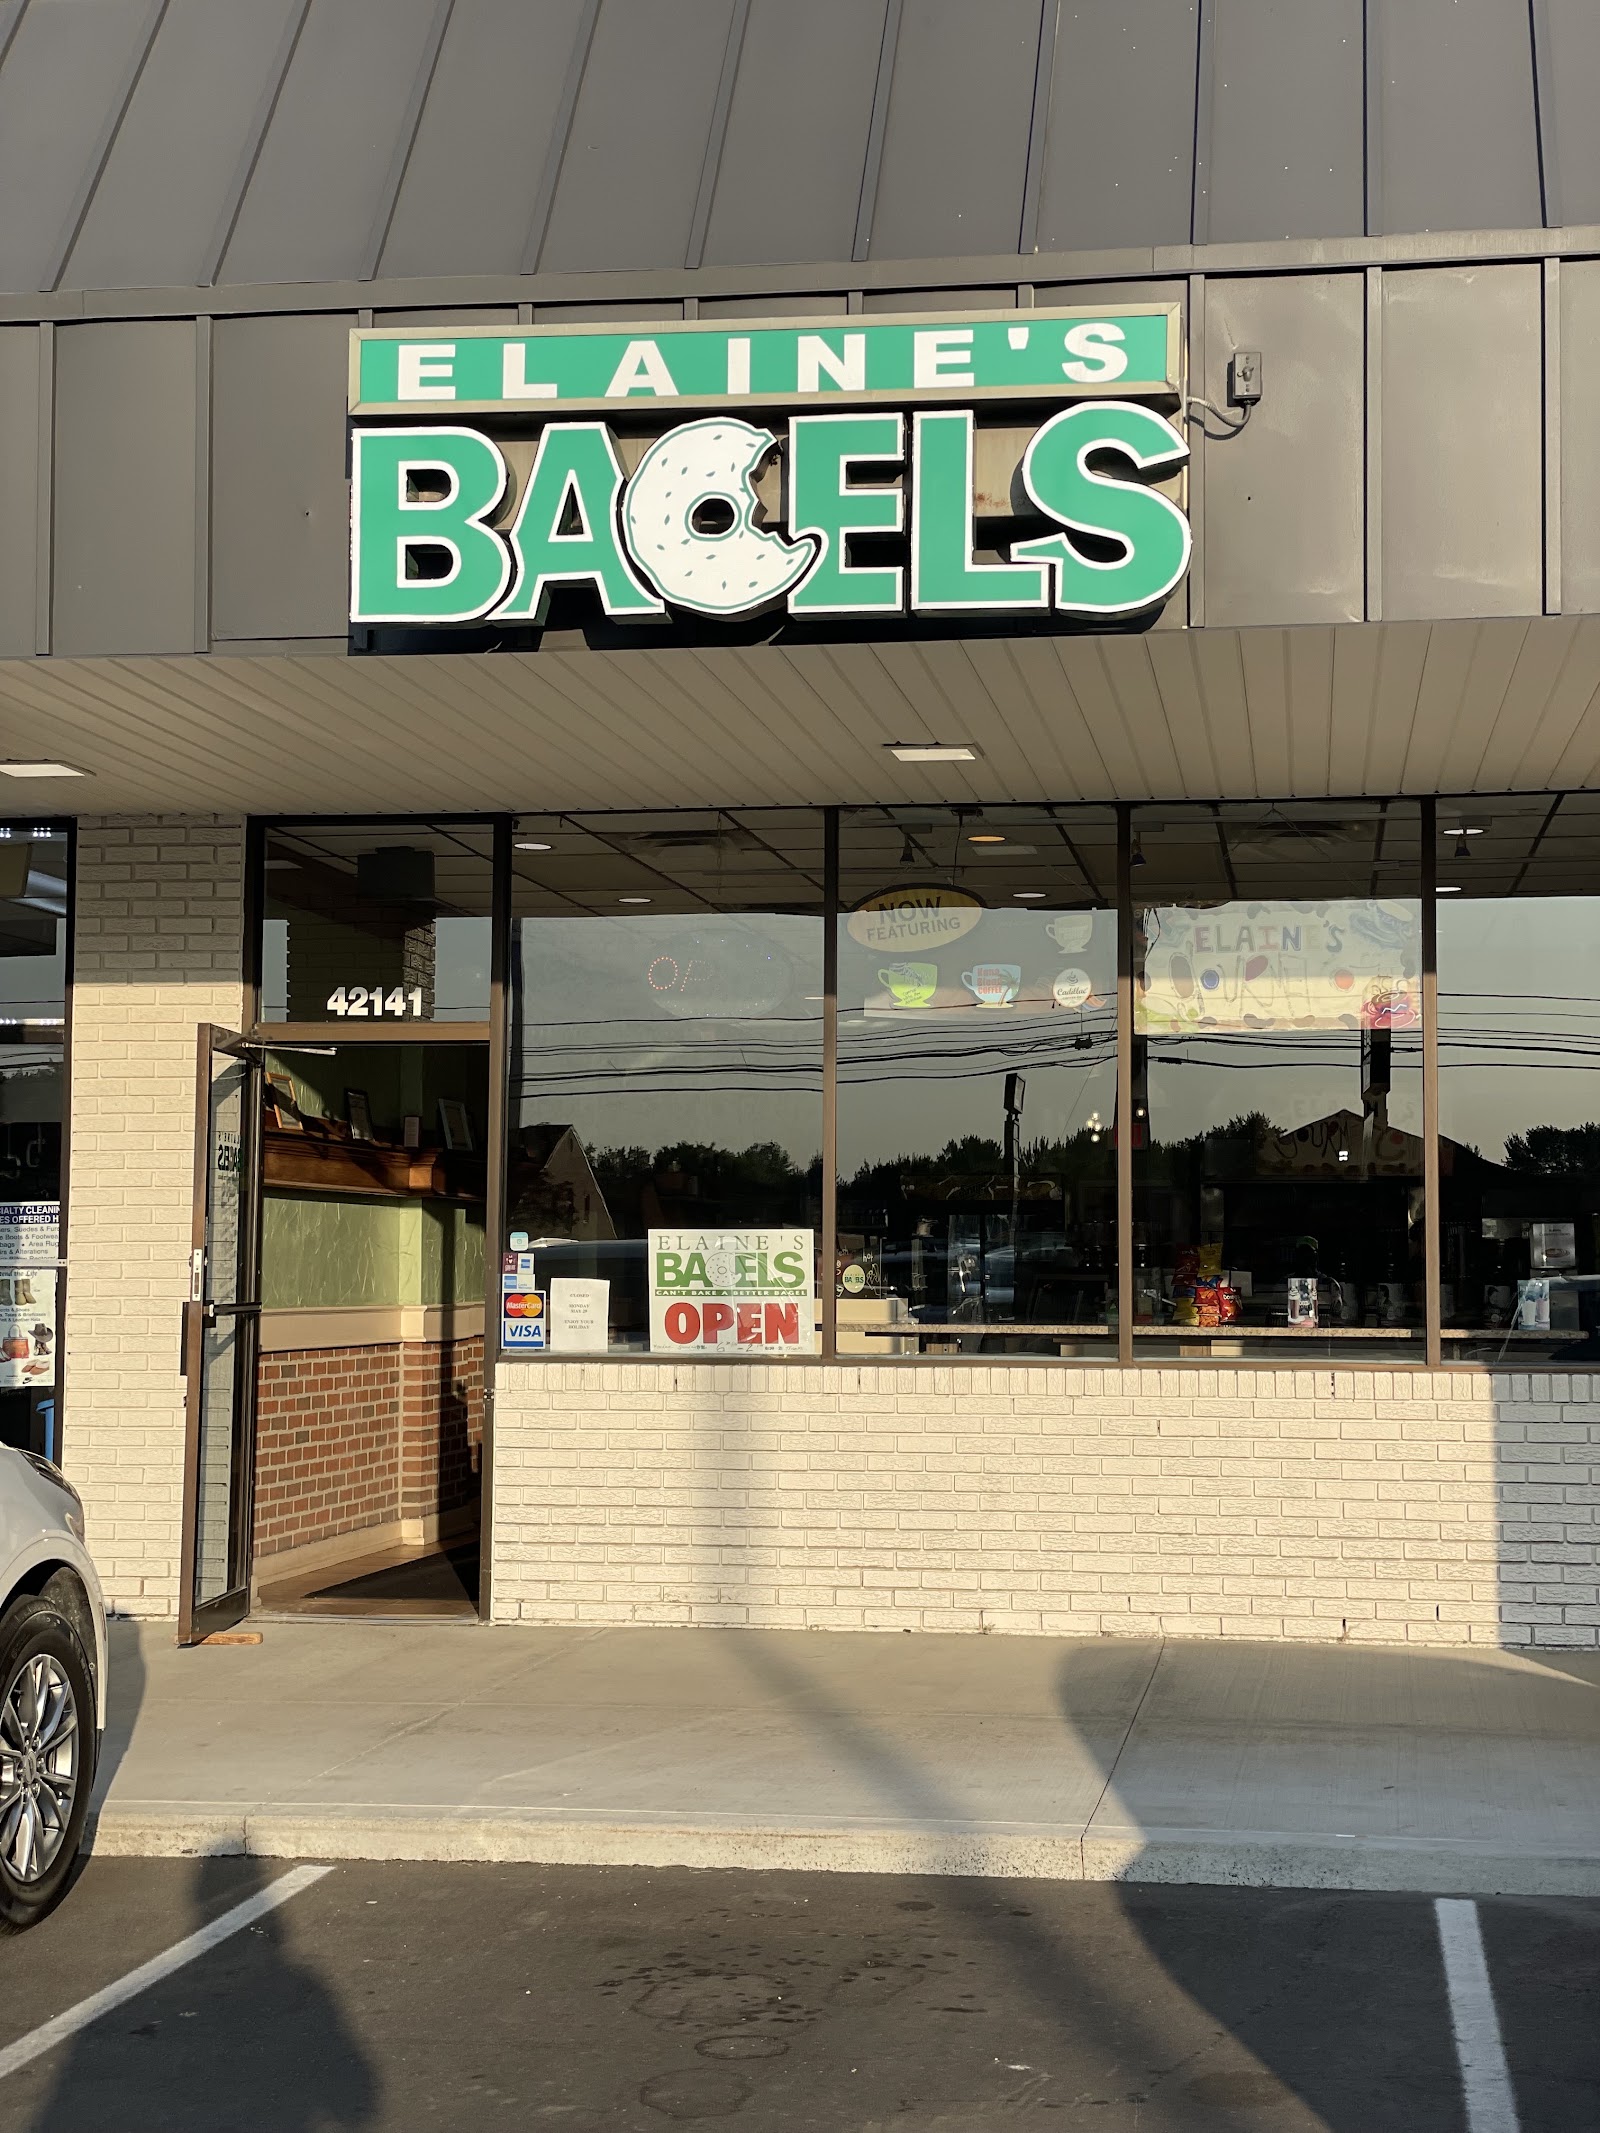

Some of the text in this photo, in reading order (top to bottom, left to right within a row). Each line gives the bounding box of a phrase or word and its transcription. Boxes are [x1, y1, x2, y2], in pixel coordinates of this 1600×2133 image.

[396, 320, 1130, 401] ELAINE'S
[350, 400, 1192, 625] BAGELS
[878, 896, 942, 925] NOW
[866, 916, 961, 942] FEATURING
[326, 986, 422, 1017] 42141
[1057, 986, 1088, 997] Cadillac
[12, 1214, 51, 1224] OFFERED
[657, 1235, 805, 1251] ELAINE'S
[506, 1301, 543, 1310] MasterCard
[509, 1324, 542, 1338] VISA
[664, 1302, 800, 1345] OPEN
